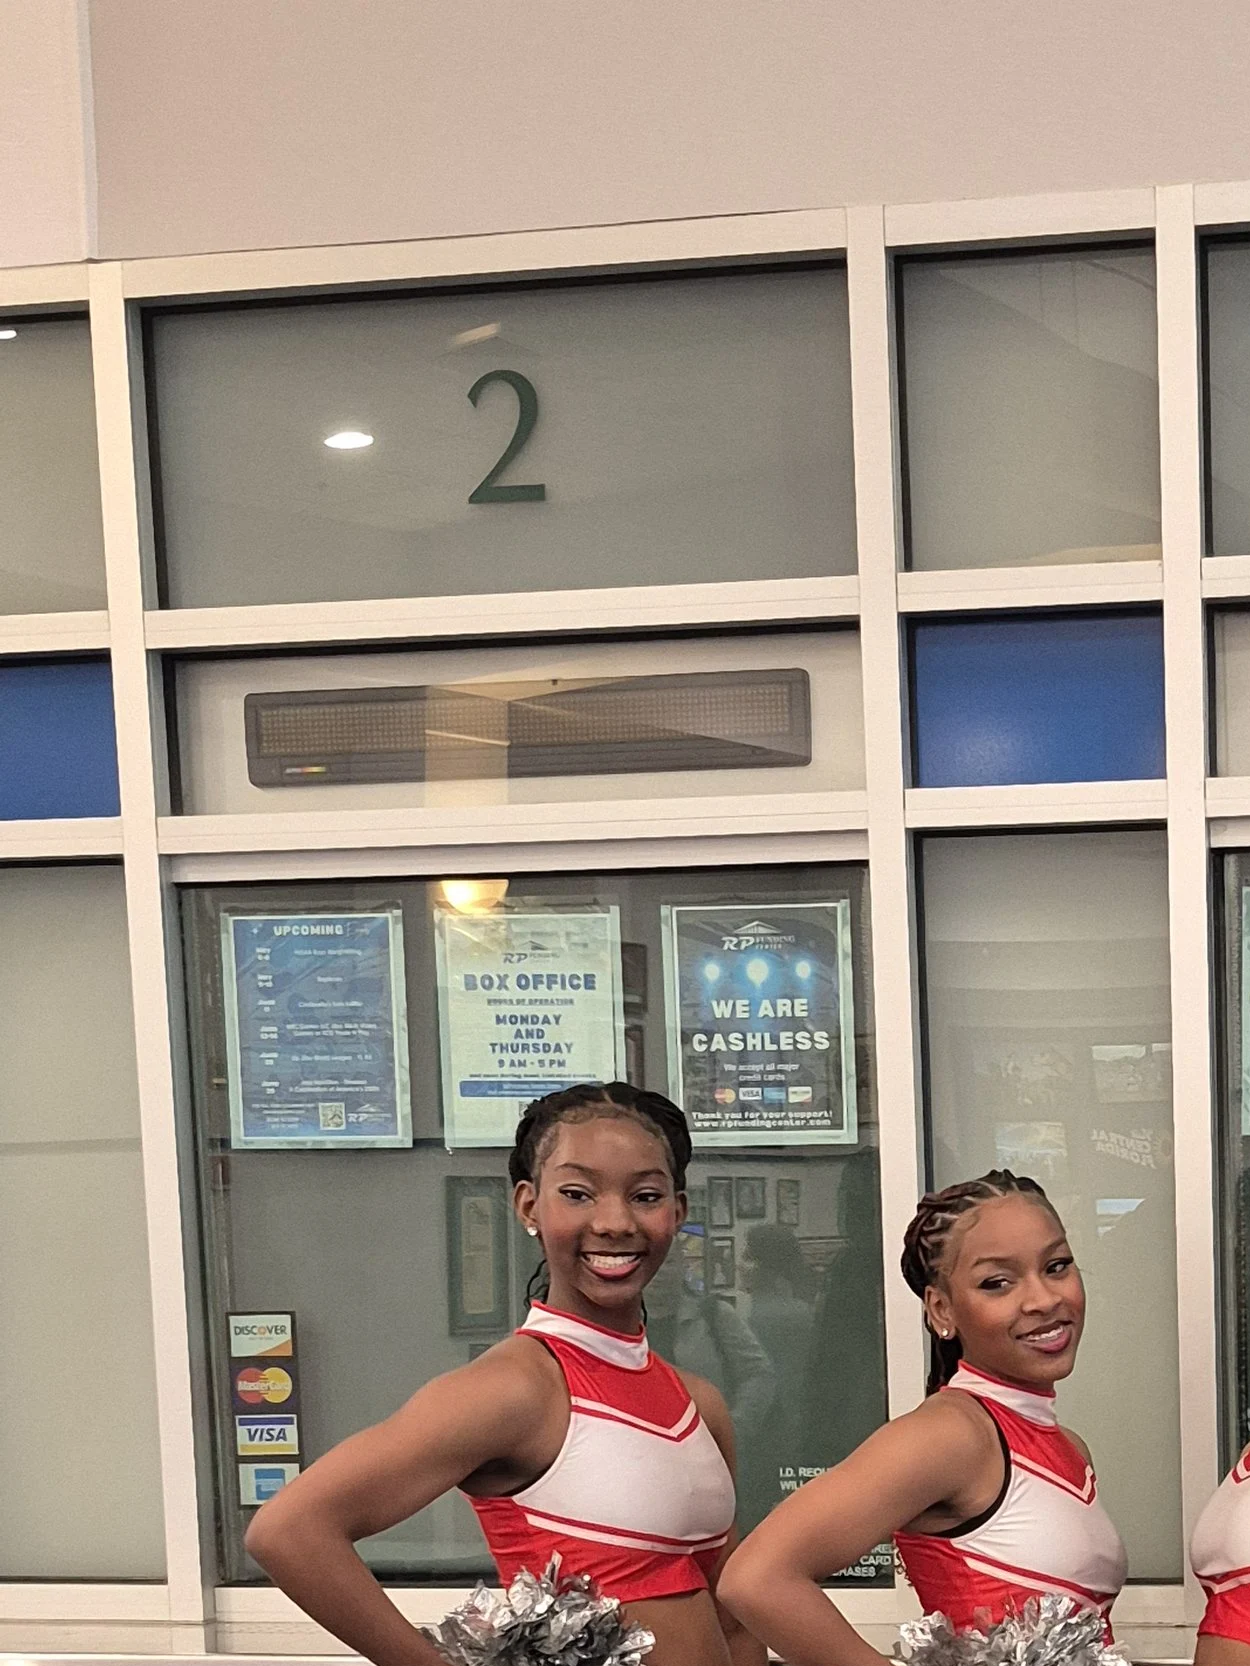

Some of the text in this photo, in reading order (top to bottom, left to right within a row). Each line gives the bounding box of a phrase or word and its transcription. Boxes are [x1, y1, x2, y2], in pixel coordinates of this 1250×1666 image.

[467, 369, 546, 504] 2
[273, 924, 344, 936] UPCOMING
[721, 936, 755, 950] RP
[464, 973, 597, 991] BOX OFFICE
[711, 998, 809, 1018] WE ARE
[495, 1014, 562, 1026] MONDAY
[514, 1028, 545, 1039] AND
[692, 1031, 830, 1052] CASHLESS
[489, 1043, 574, 1054] THURSDAY
[498, 1059, 505, 1068] 9
[509, 1059, 526, 1068] AM
[538, 1059, 546, 1068] 5
[549, 1059, 566, 1068] PM
[692, 1111, 833, 1120] Thank you for your support!
[694, 1118, 831, 1128] www.rpfundingcenter.com
[233, 1325, 287, 1336] DISCOVER
[246, 1427, 287, 1442] VISA
[780, 1467, 796, 1478] I.D.
[860, 1555, 892, 1566] CARD
